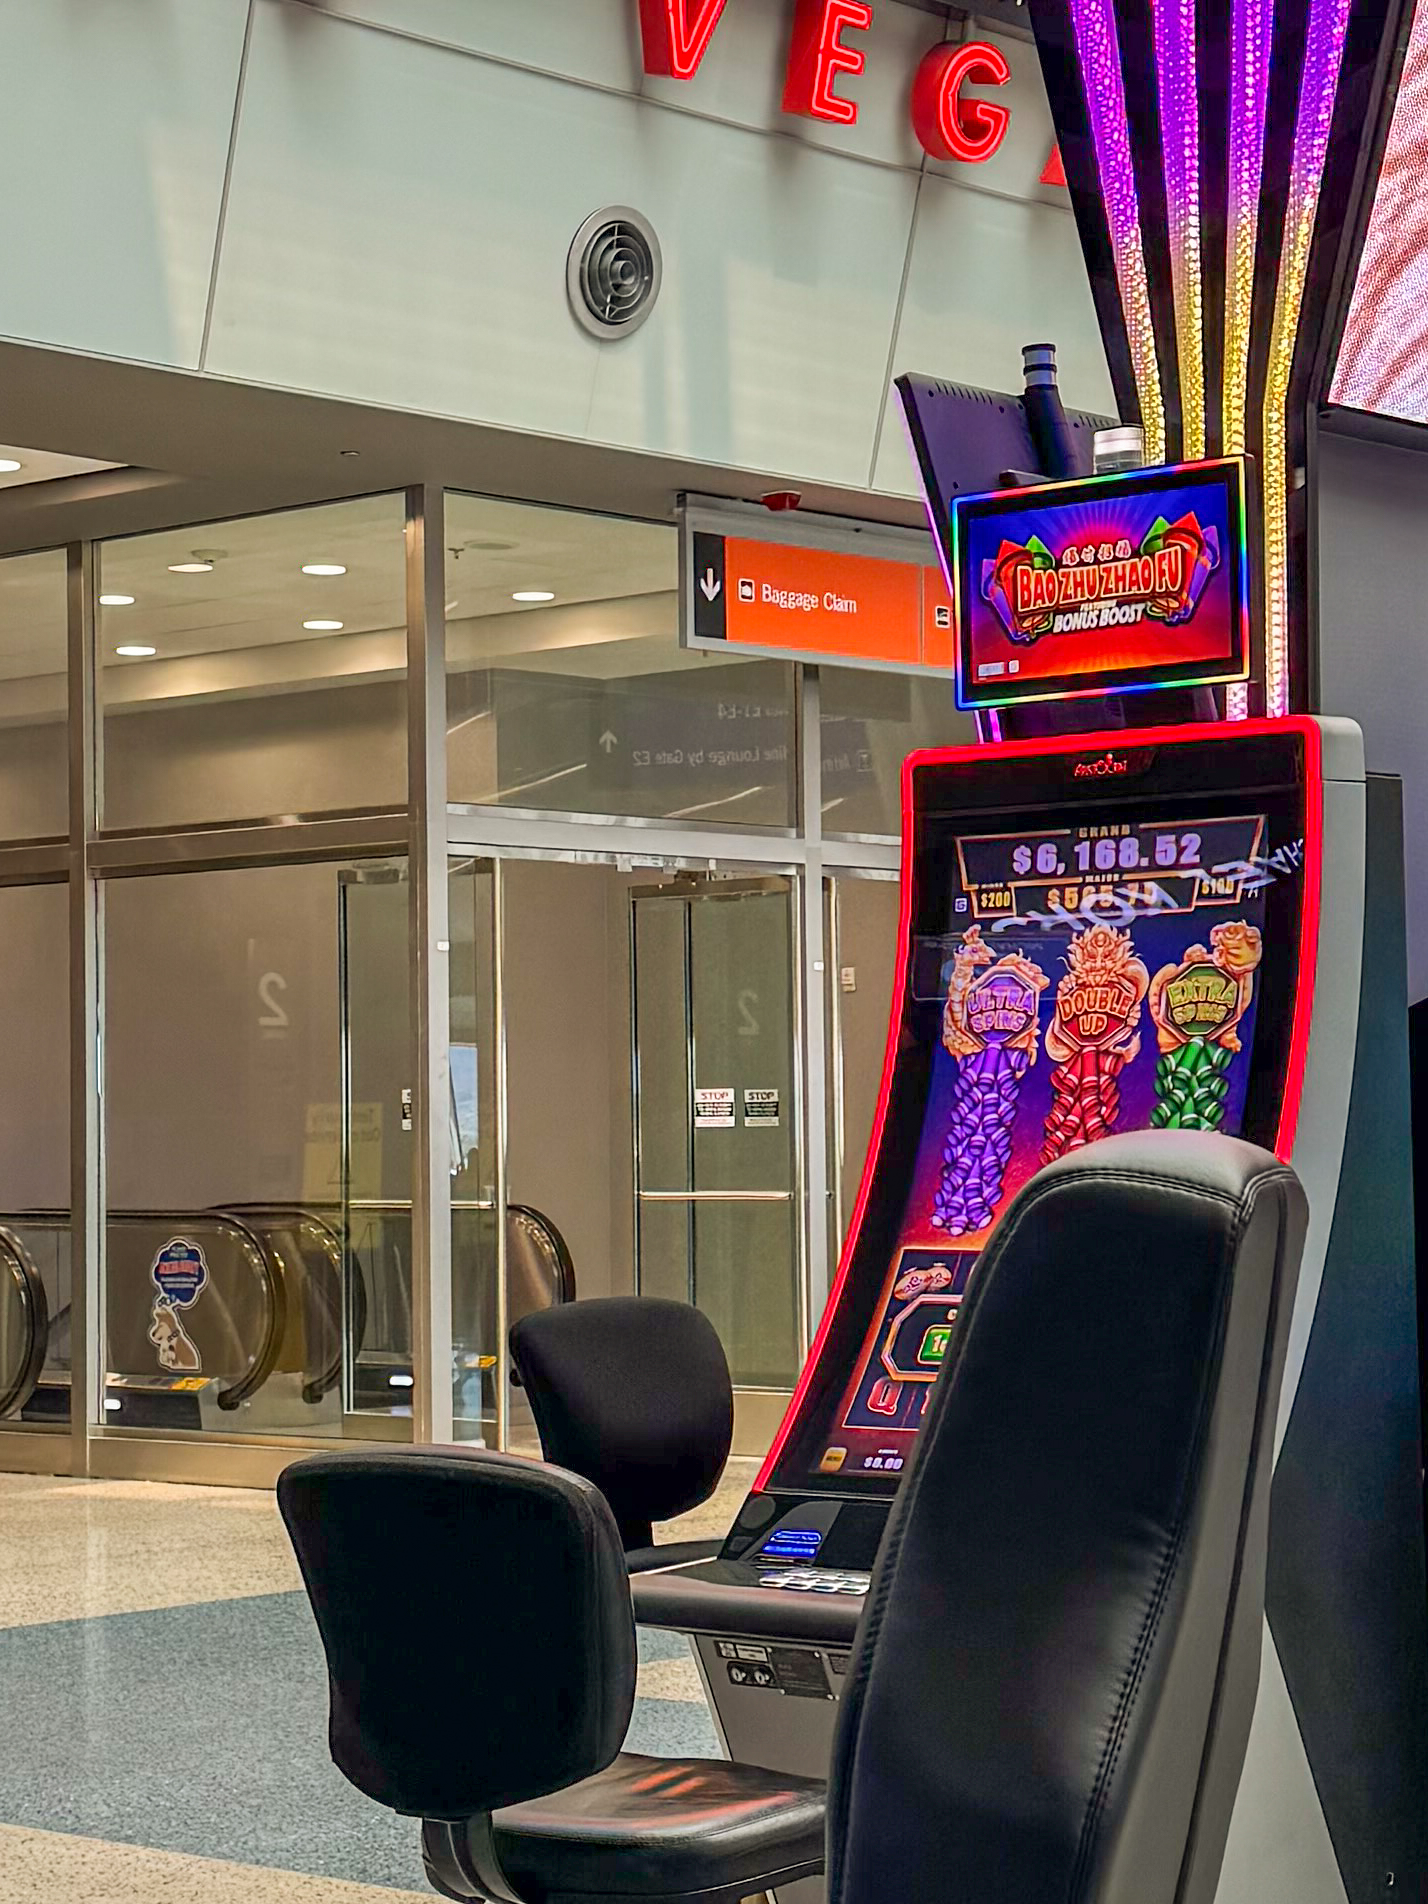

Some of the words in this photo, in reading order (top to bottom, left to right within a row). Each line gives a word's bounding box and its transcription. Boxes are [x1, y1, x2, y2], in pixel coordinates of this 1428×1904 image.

[1016, 565, 1058, 613] BAO
[1059, 565, 1099, 604] ZHU
[1100, 556, 1154, 598] ZHAO
[1155, 545, 1182, 593] FU
[761, 583, 819, 612] Baggage
[823, 592, 857, 613] Claim
[1053, 608, 1099, 633] BONUS
[1099, 602, 1146, 627] BOOST
[1012, 833, 1202, 876] $6,168.52
[980, 892, 1011, 908] $200
[1058, 987, 1135, 1021] DOUBLE
[1078, 1014, 1108, 1035] UP
[864, 1457, 904, 1470] $0.00
